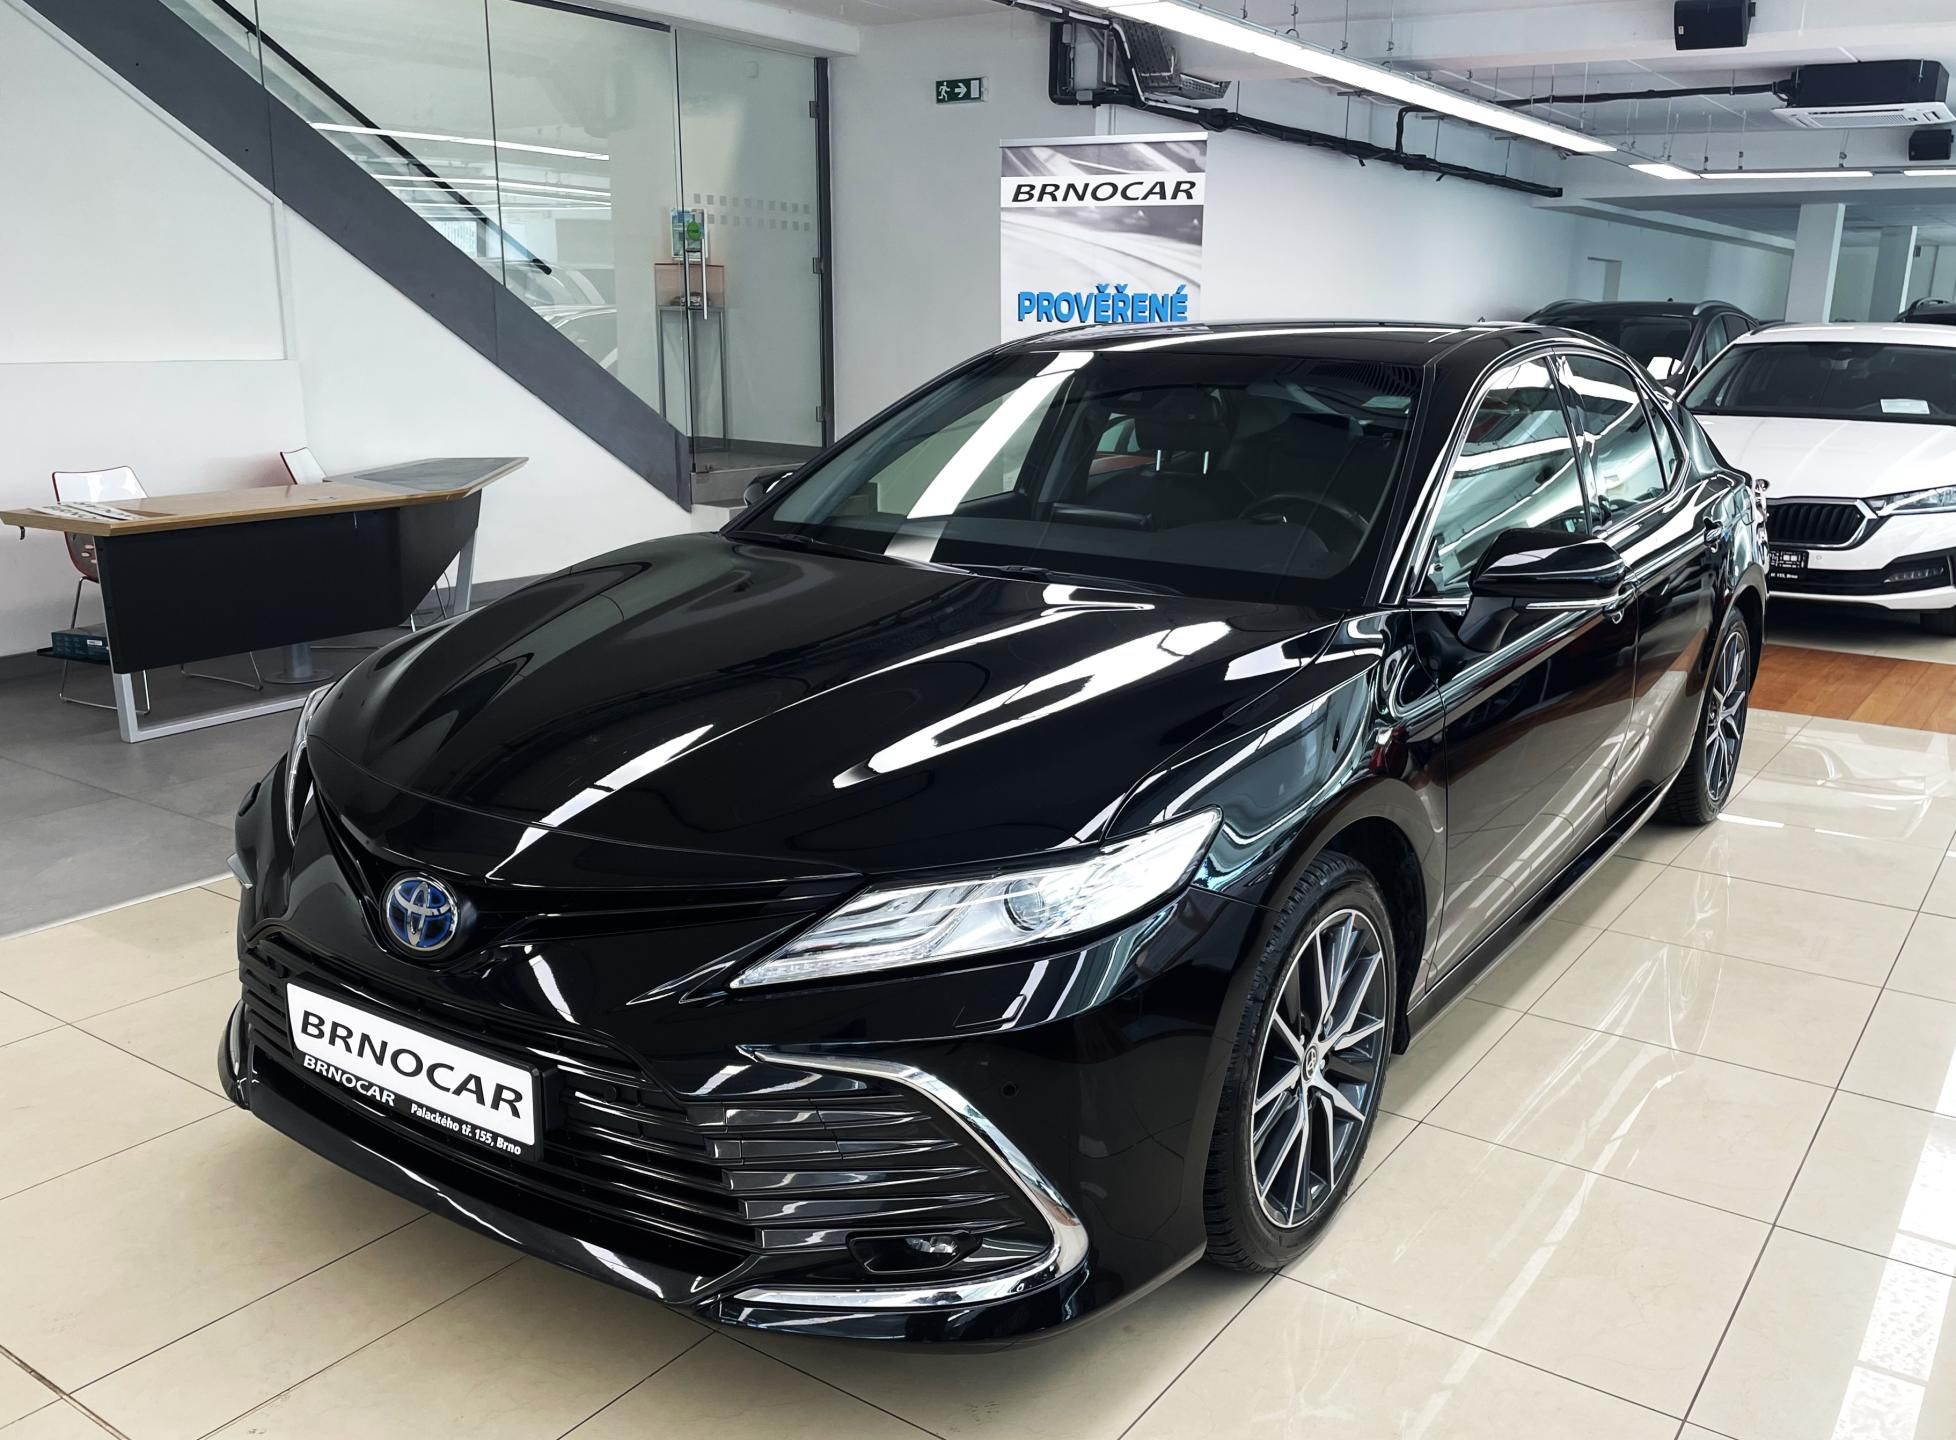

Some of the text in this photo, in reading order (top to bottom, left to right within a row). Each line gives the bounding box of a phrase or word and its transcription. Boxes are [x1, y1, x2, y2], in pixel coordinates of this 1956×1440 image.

[1011, 180, 1196, 203] BRNOCAR
[1017, 283, 1188, 323] PROVĚŘENÉ
[301, 1009, 523, 1119] BRNOCAR
[303, 1054, 395, 1107] BRNOCAR
[410, 1103, 522, 1155] Palackého tř. 155, Brno
